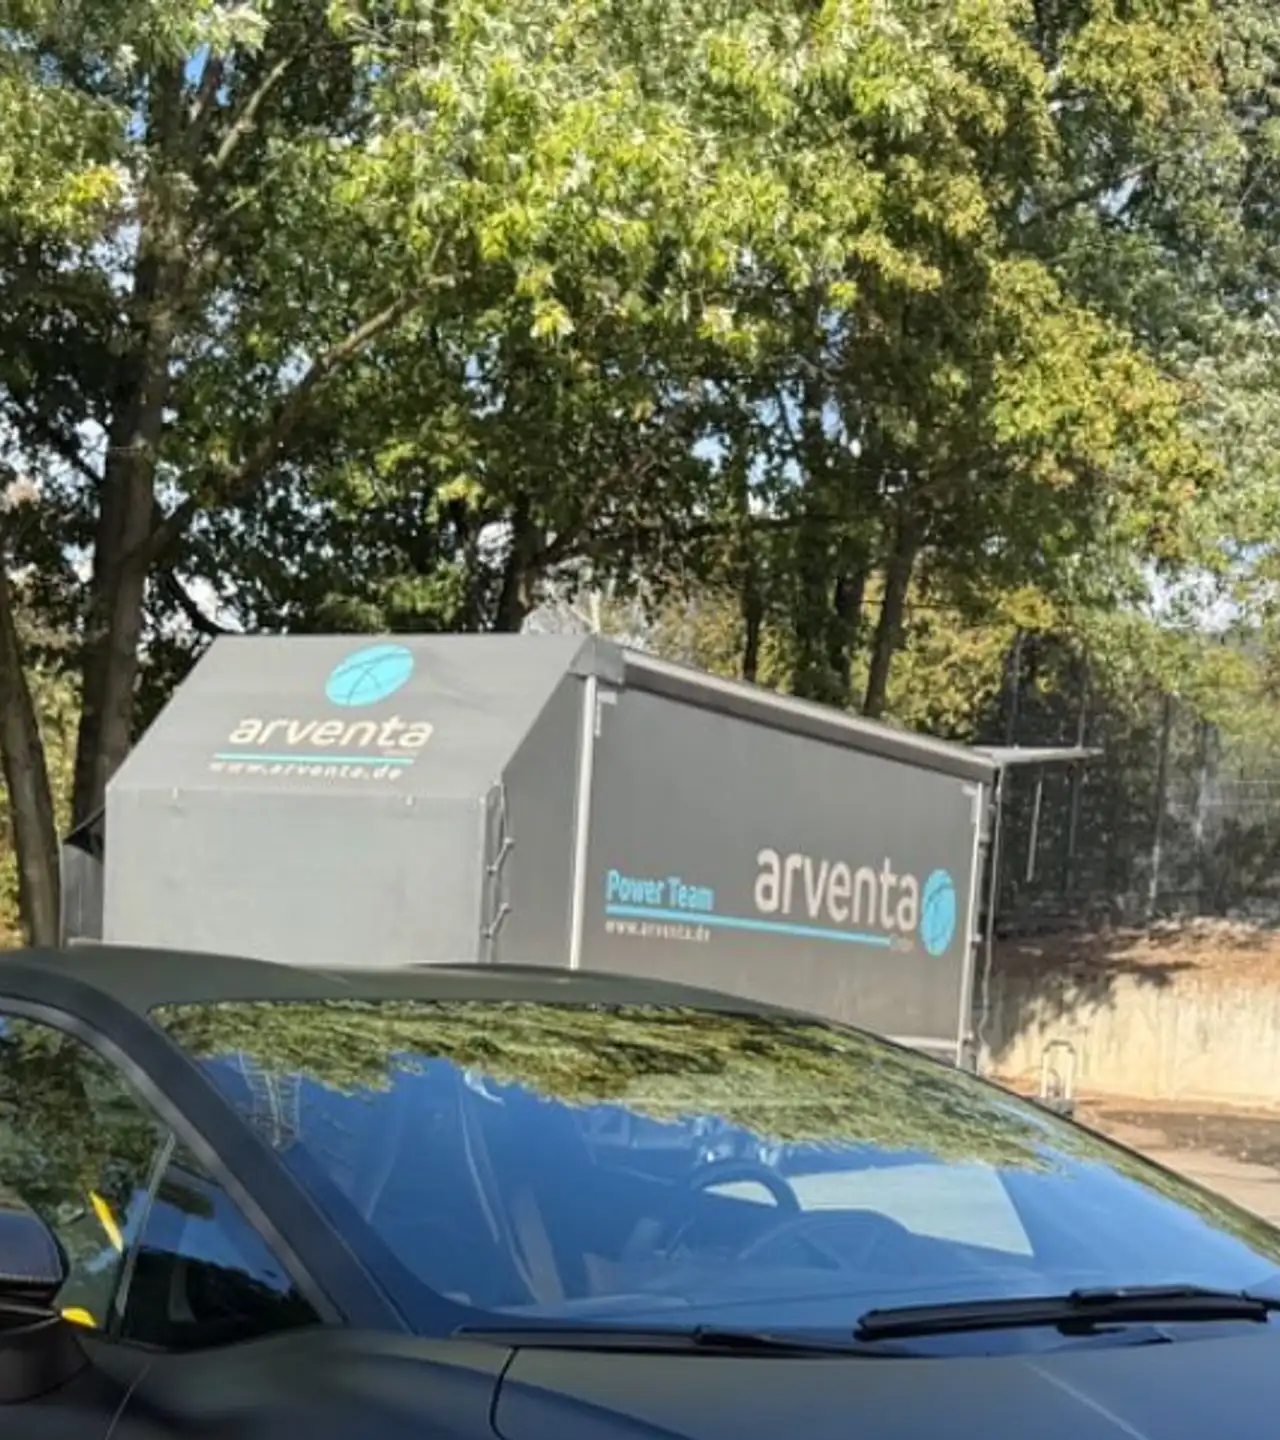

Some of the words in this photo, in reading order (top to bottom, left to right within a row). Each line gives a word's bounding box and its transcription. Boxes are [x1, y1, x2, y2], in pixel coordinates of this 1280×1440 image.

[228, 715, 433, 747] arventa
[210, 762, 404, 780] www.arventa.de
[605, 869, 664, 905] Power
[668, 875, 714, 912] Team
[754, 848, 918, 931] arventa
